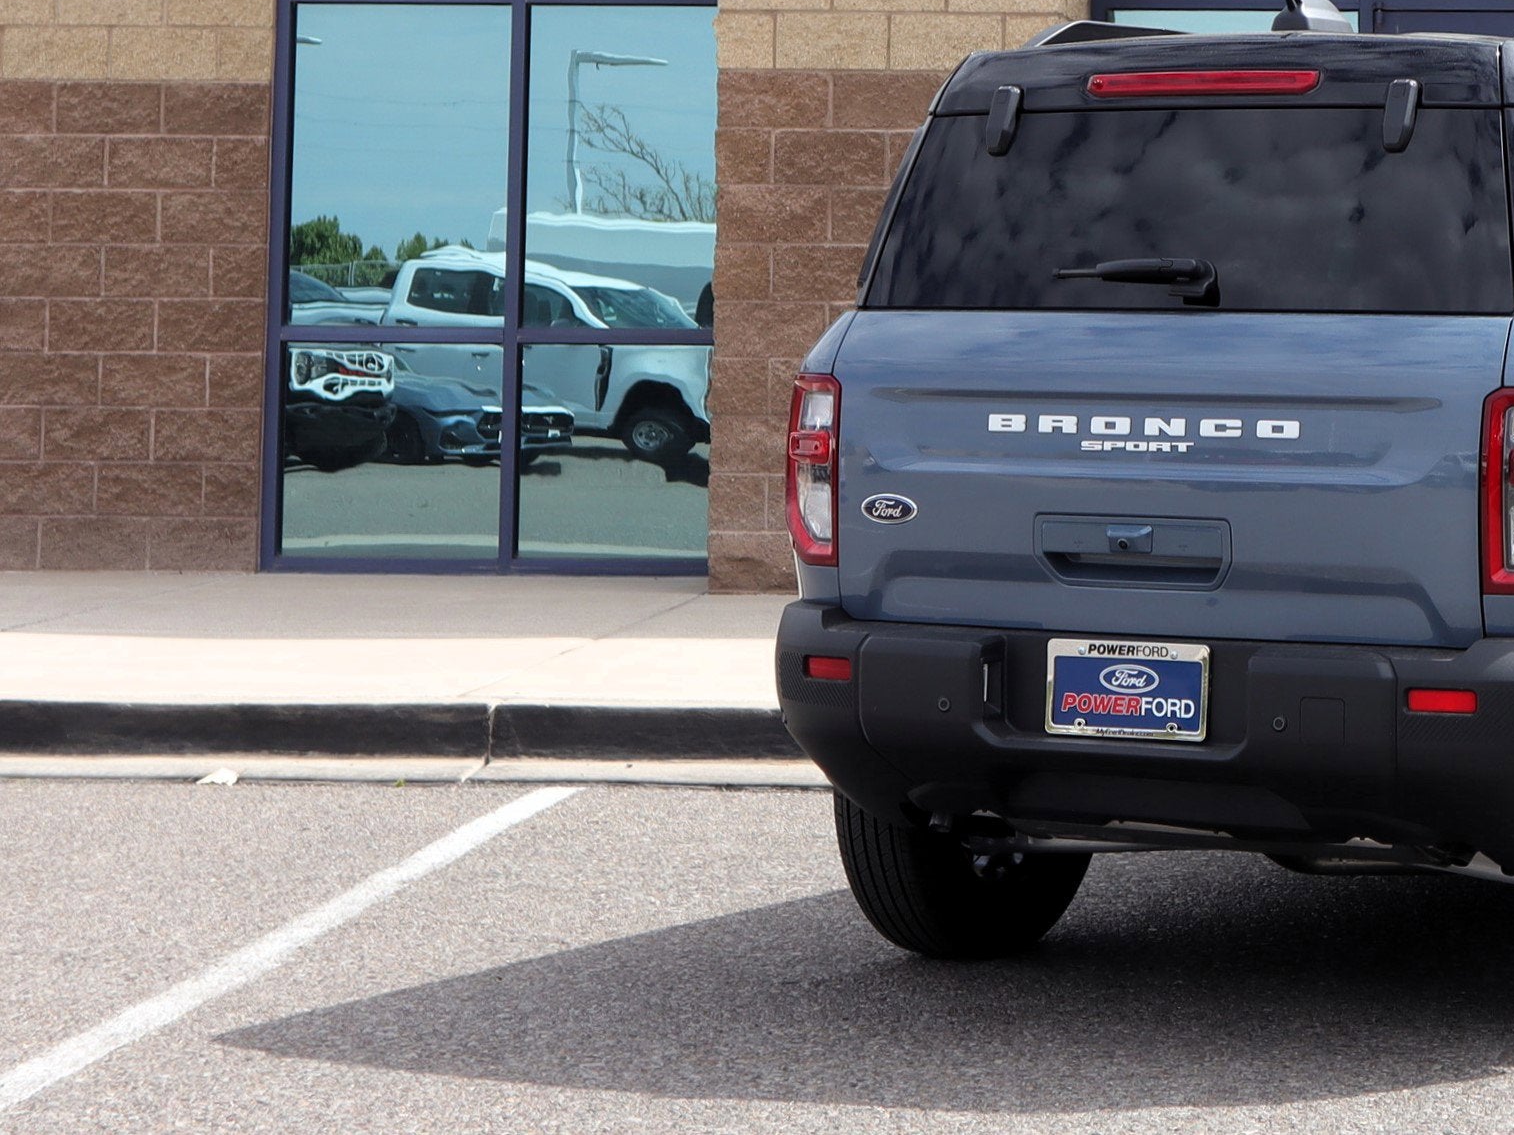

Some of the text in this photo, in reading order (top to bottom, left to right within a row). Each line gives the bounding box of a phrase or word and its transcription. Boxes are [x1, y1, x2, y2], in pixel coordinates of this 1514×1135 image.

[988, 413, 1300, 439] BRONCO
[1080, 440, 1195, 453] SPORT
[872, 499, 903, 518] Ford
[1088, 643, 1169, 658] POWERFORD
[1111, 669, 1147, 688] Ford
[1061, 692, 1195, 719] POWERFORD
